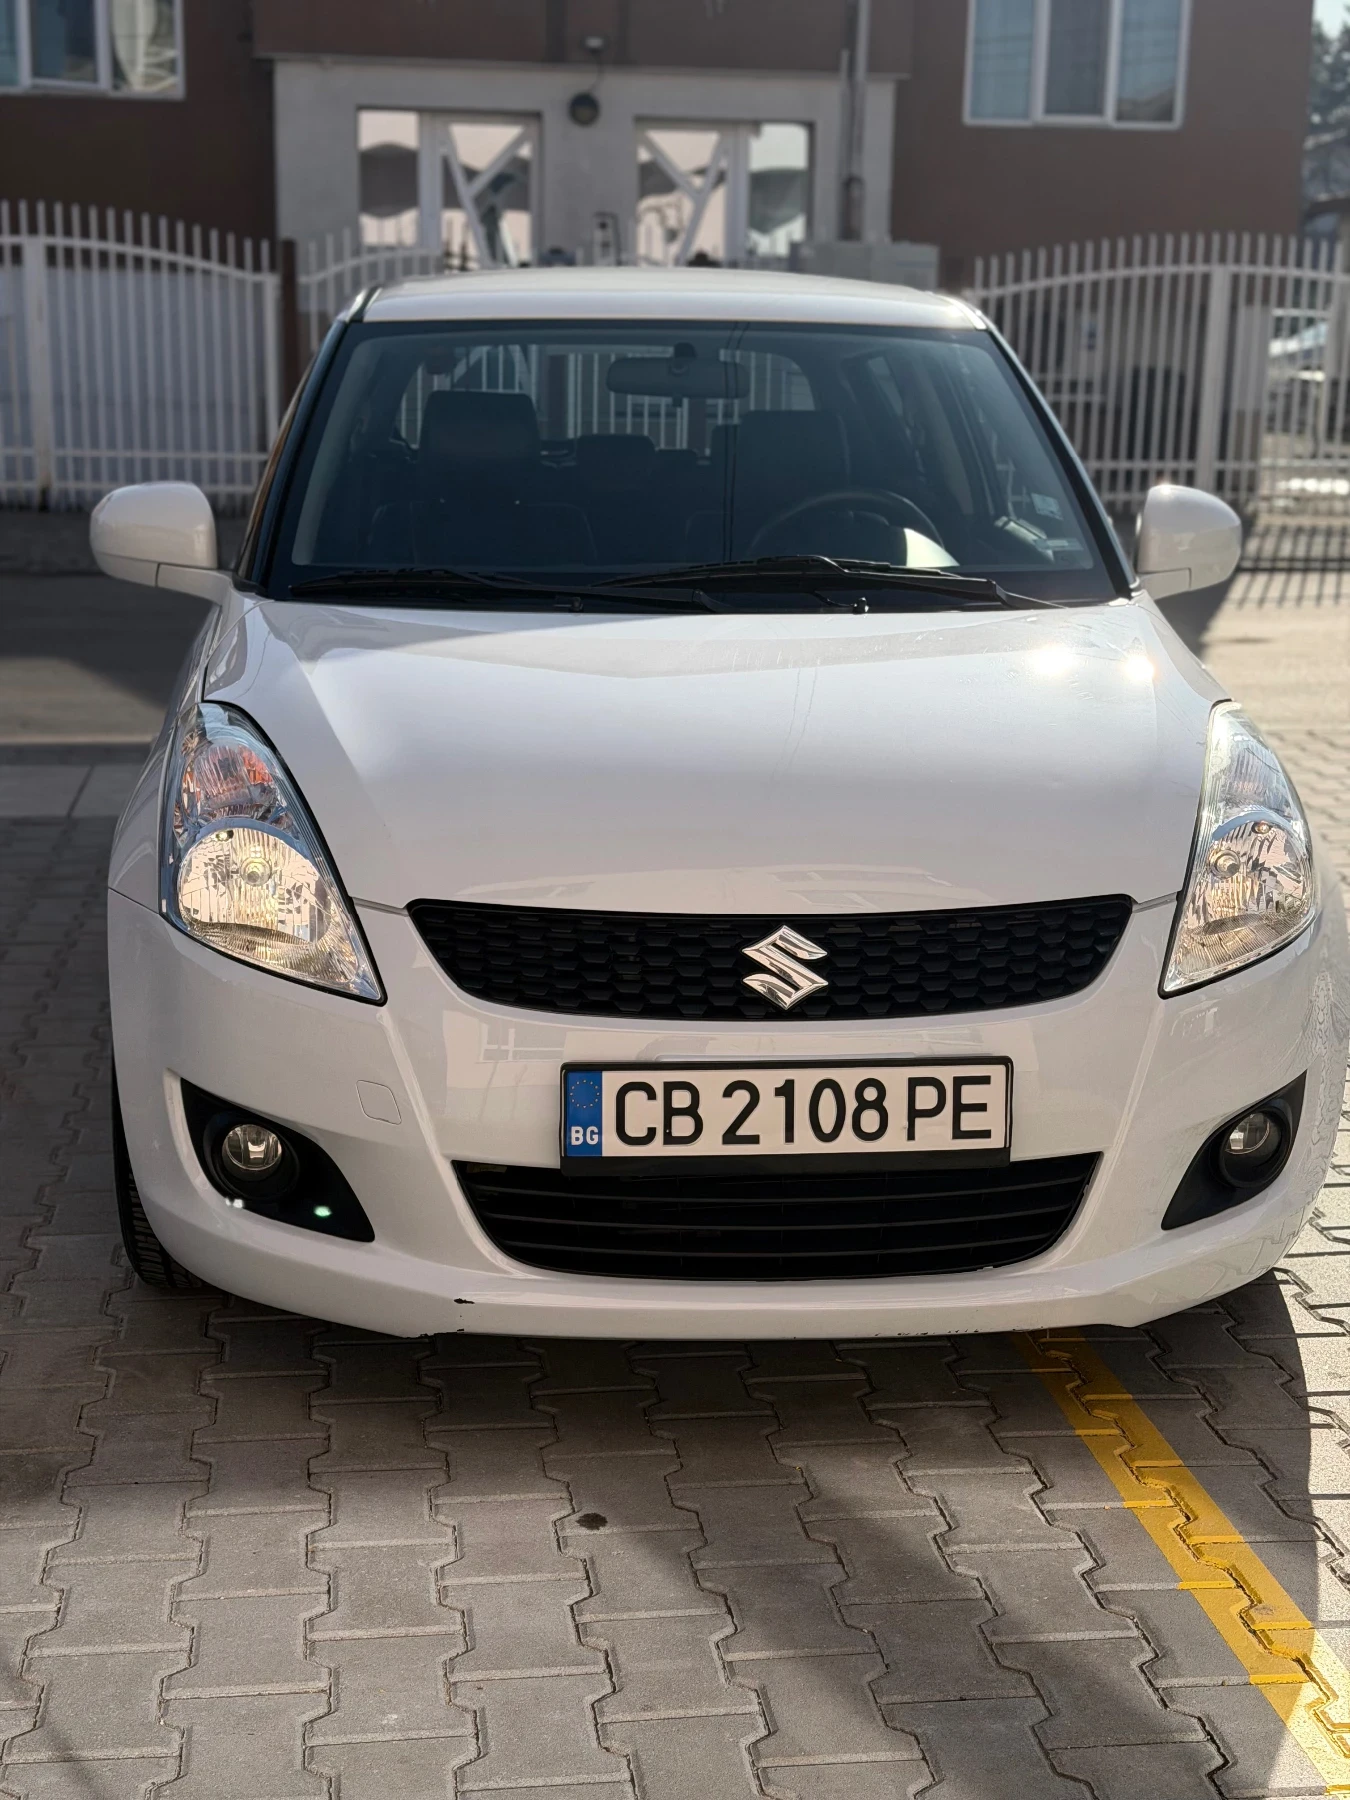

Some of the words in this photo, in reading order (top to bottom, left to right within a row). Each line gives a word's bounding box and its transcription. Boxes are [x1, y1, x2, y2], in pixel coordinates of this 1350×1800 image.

[615, 1081, 704, 1147] CB
[721, 1077, 889, 1146] 2108
[907, 1075, 992, 1142] PE
[570, 1126, 599, 1146] BG
